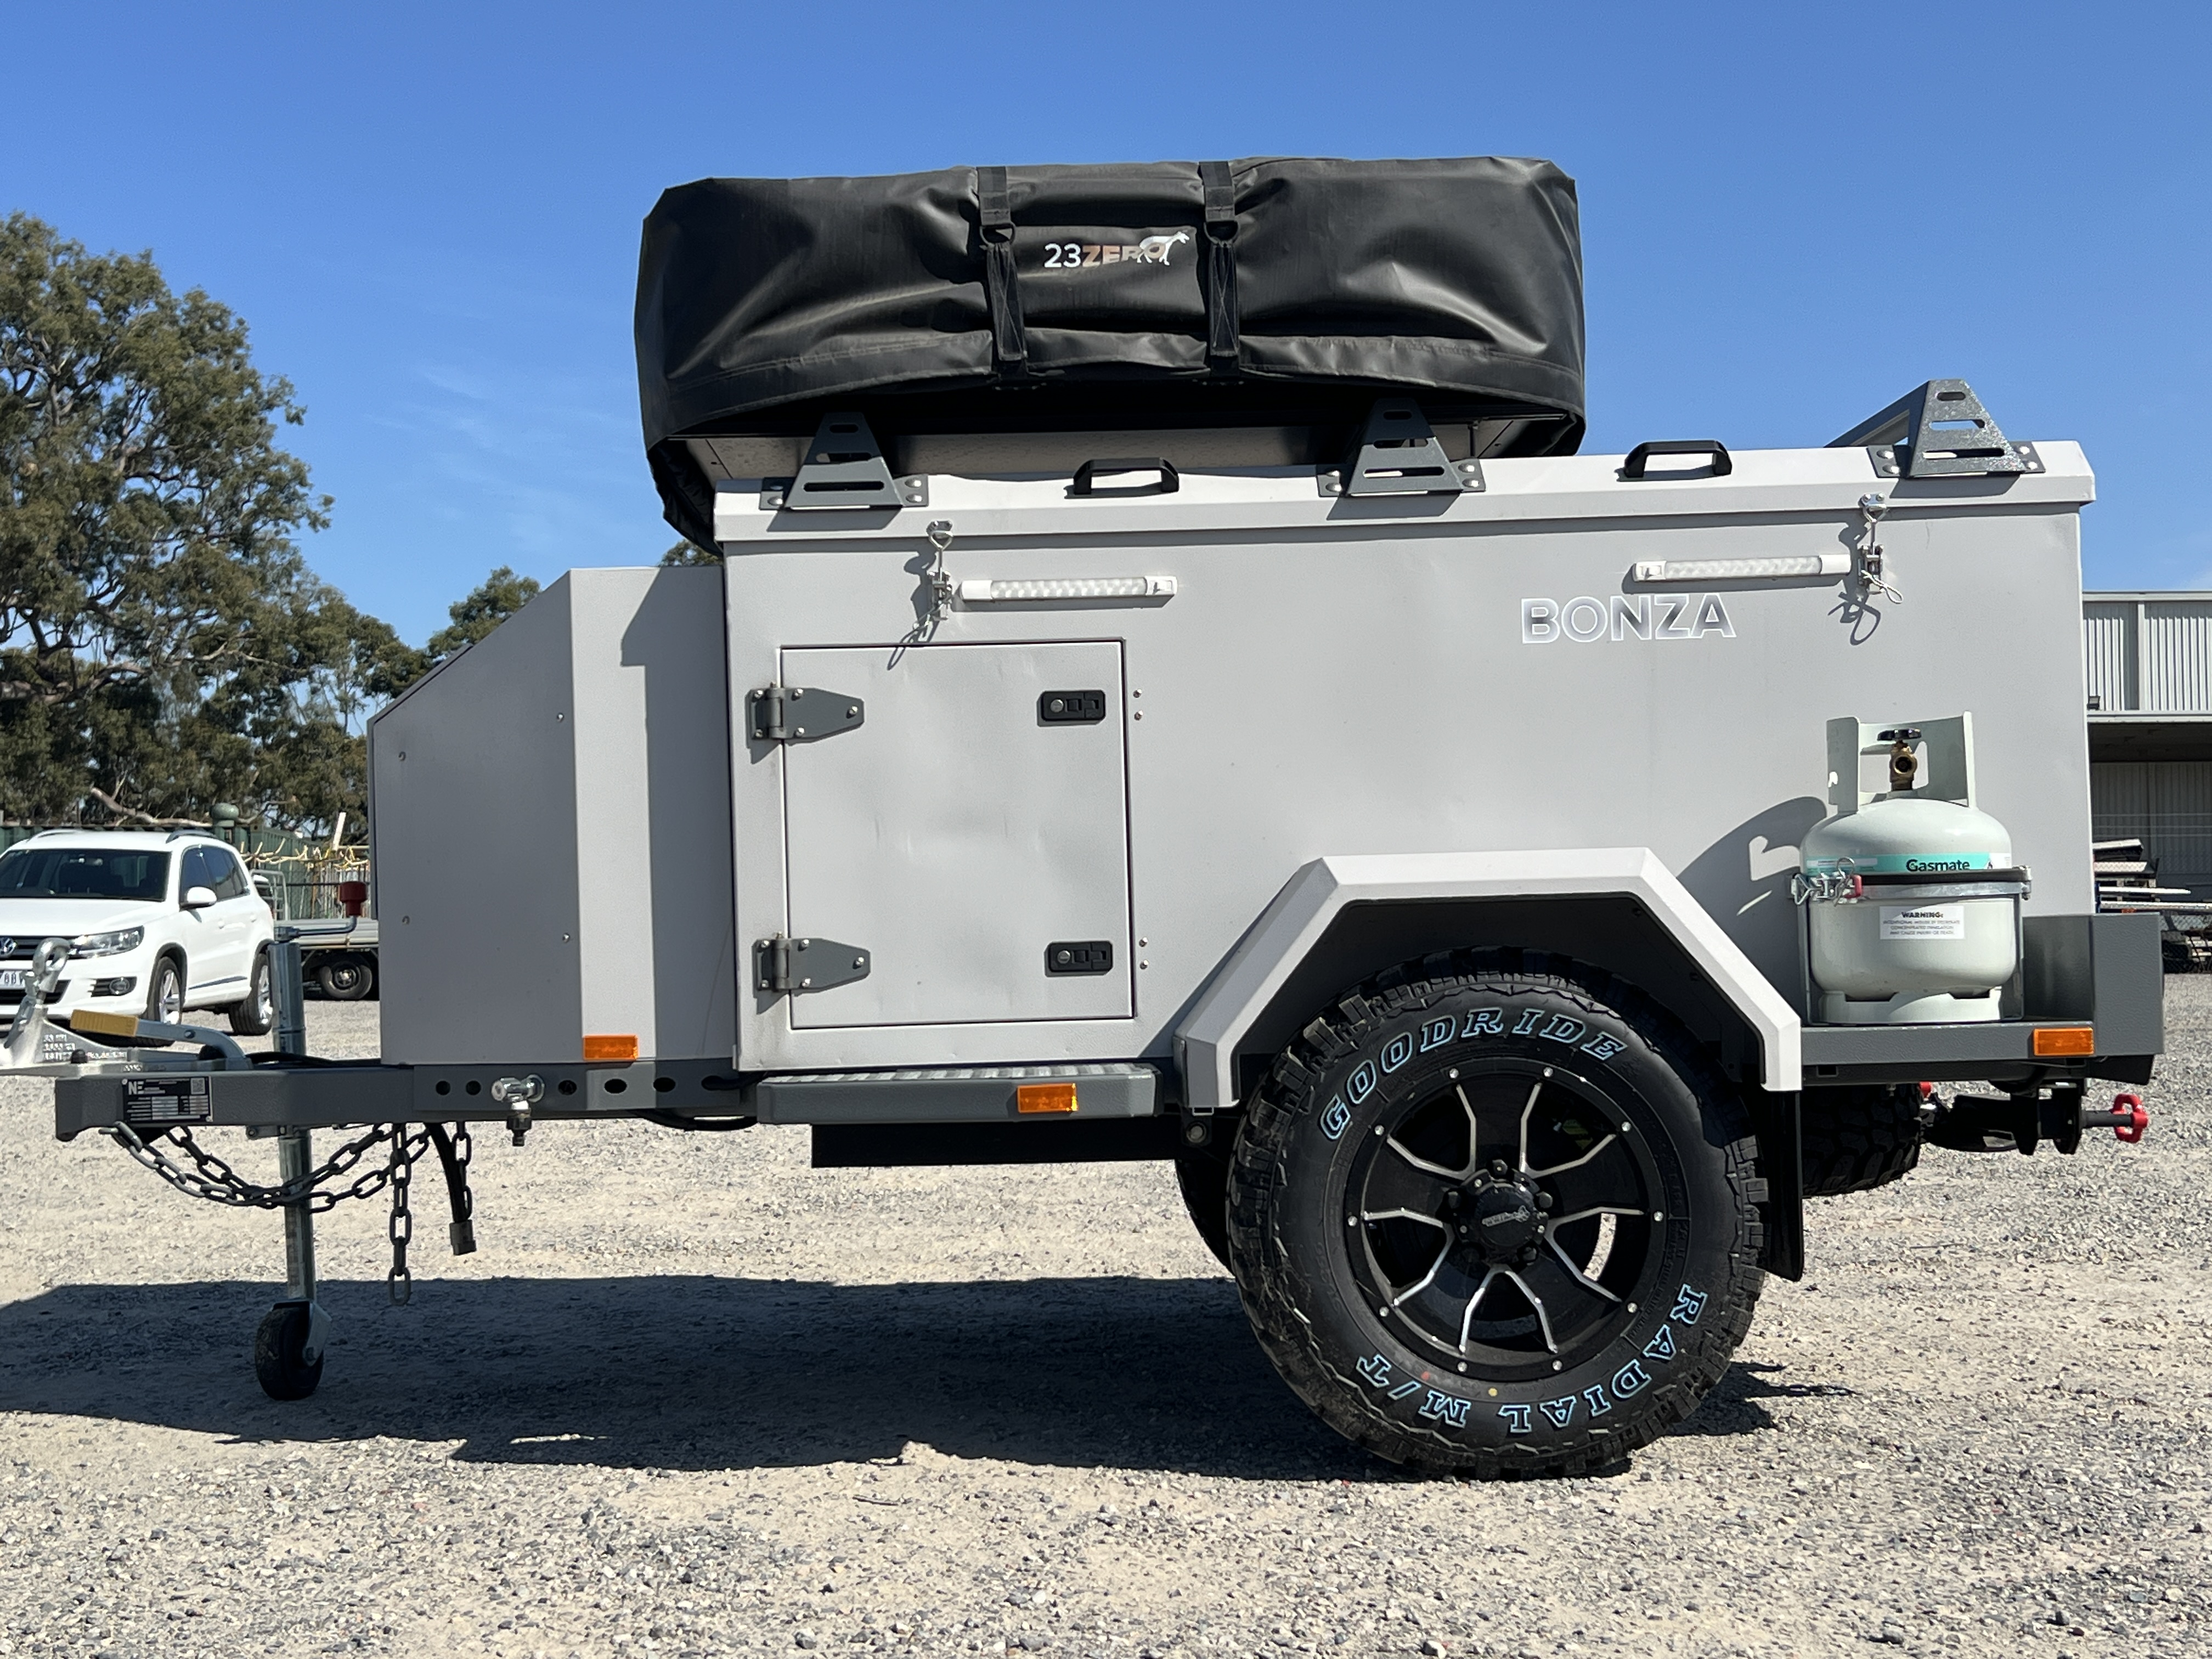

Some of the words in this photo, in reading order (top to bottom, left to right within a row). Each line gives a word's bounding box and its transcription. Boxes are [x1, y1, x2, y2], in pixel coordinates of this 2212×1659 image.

[1045, 242, 1166, 268] 23ZERO
[1521, 592, 1737, 644] BONZA
[1906, 859, 1970, 872] Gasmate
[1319, 1005, 1627, 1140] GOODRIDE
[1356, 1352, 1471, 1429] M/T
[1495, 1283, 1708, 1435] RADIAL
